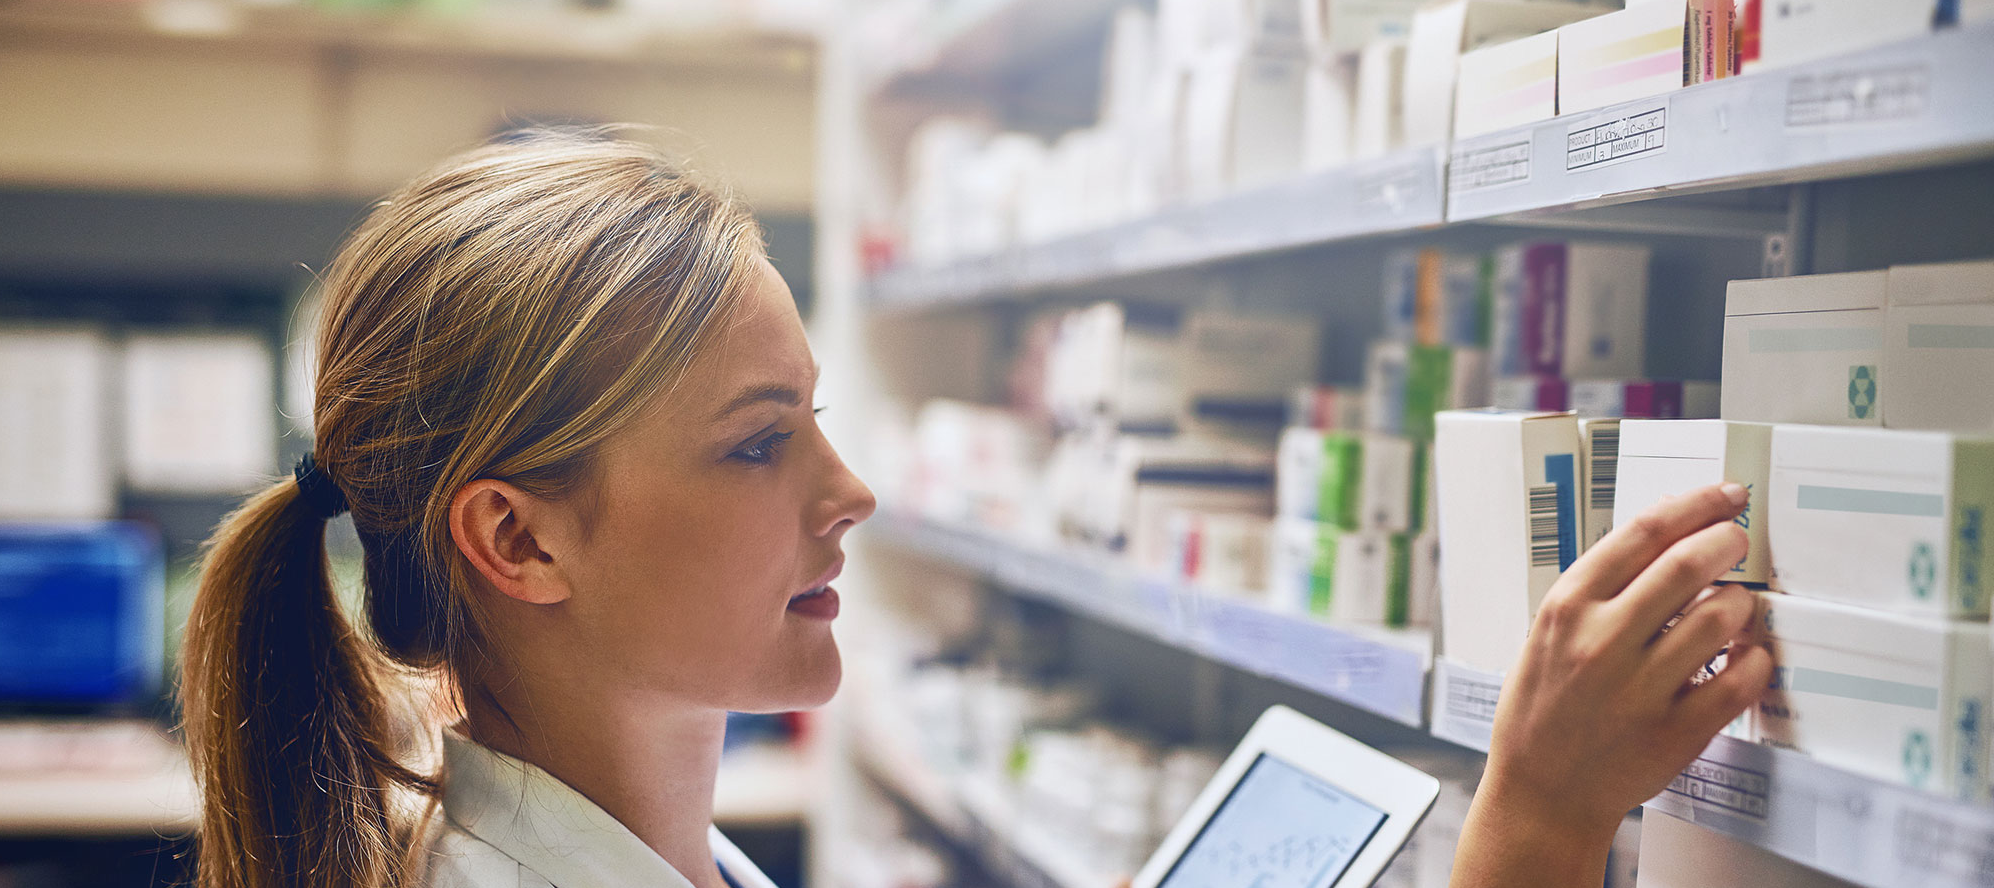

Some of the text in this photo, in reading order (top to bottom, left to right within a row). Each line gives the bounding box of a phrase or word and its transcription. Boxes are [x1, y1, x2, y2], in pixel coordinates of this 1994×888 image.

[1705, 15, 1711, 26] mg
[1612, 138, 1640, 153] MAXIMUM
[1568, 150, 1592, 164] MINIMUM
